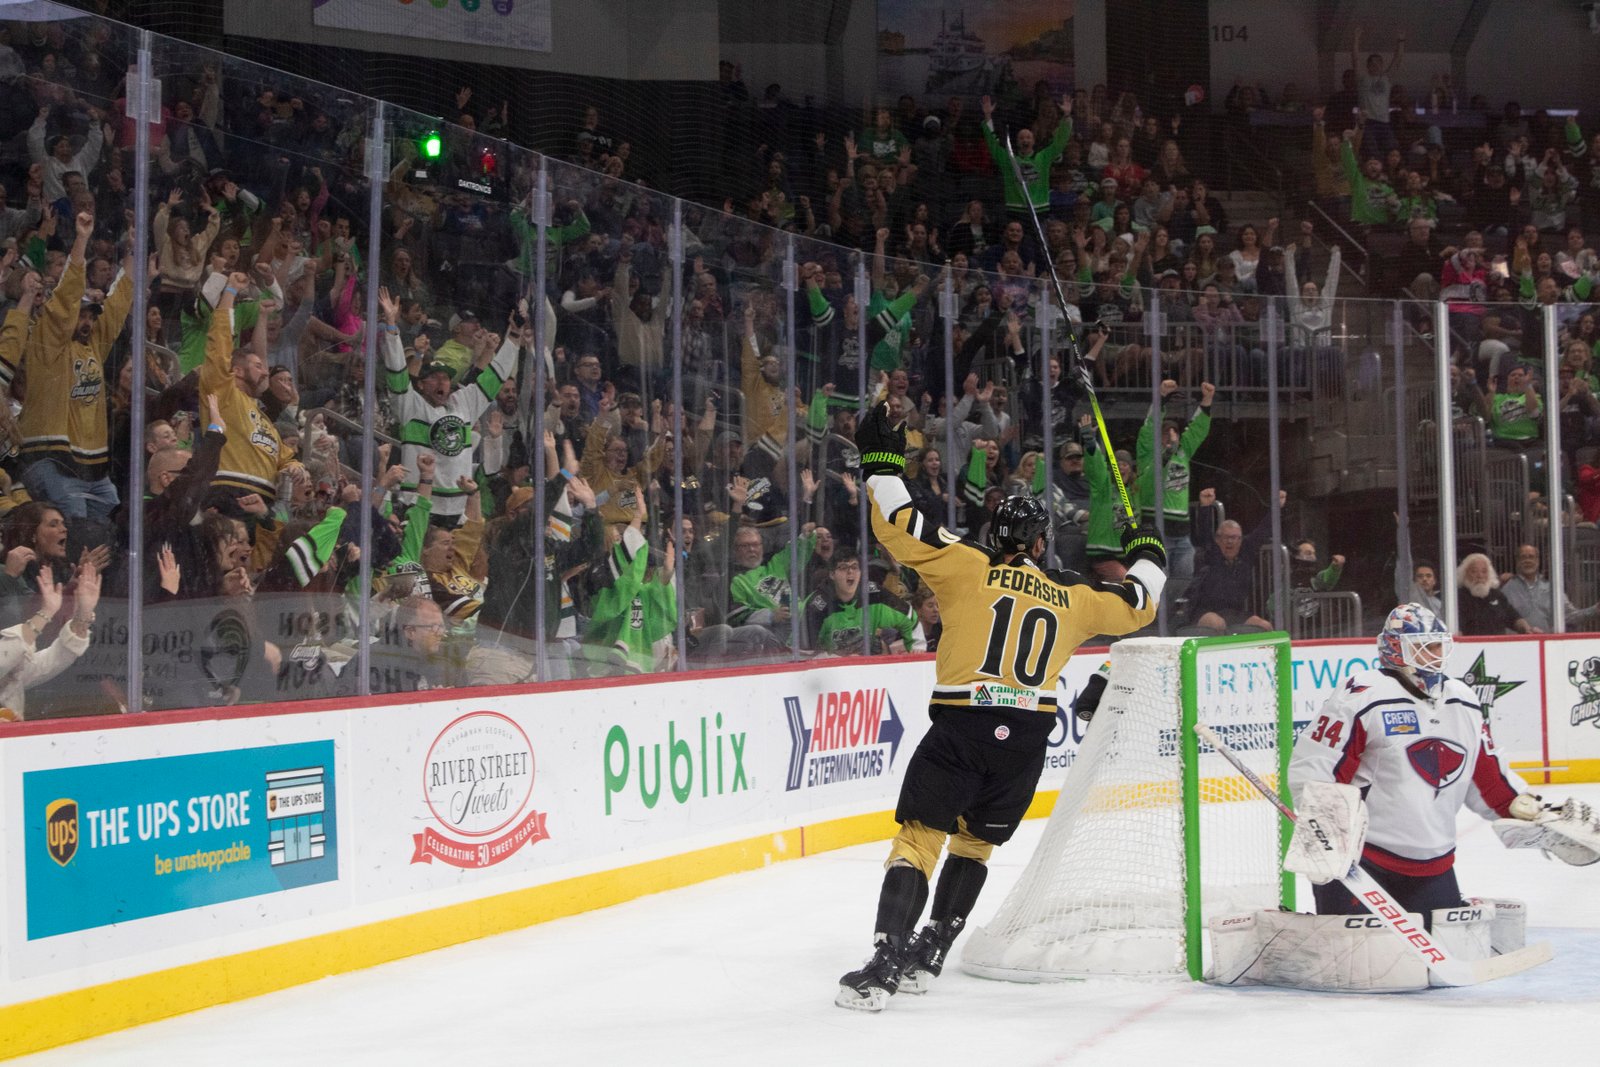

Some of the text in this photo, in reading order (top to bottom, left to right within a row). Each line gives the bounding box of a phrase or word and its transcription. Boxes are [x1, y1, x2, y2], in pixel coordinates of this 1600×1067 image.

[1211, 25, 1248, 42] 104
[459, 179, 492, 195] DAKTRONICS
[999, 525, 1009, 537] 10
[986, 568, 1070, 609] PEDERSEN
[975, 594, 1057, 687] 10
[989, 685, 1036, 697] campers
[997, 694, 1032, 708] inn RV
[810, 687, 886, 753] ARROW
[1385, 711, 1417, 725] CREWS
[1571, 699, 1600, 725] GHOS
[1311, 715, 1344, 748] 34
[432, 752, 528, 787] RIVER STREET
[603, 711, 749, 816] Publix
[807, 749, 884, 788] EXTERMINATORS
[279, 792, 322, 808] THE UPS STORE
[450, 780, 510, 825] Sweets
[86, 790, 250, 849] THE UPS STORE
[1309, 819, 1333, 851] CCM
[49, 819, 77, 856] ups
[427, 818, 536, 867] CELEBRATING 50 SWEET YEARS
[155, 840, 251, 875] be unstoppable
[1344, 917, 1388, 929] CC
[1446, 909, 1482, 923] CCM
